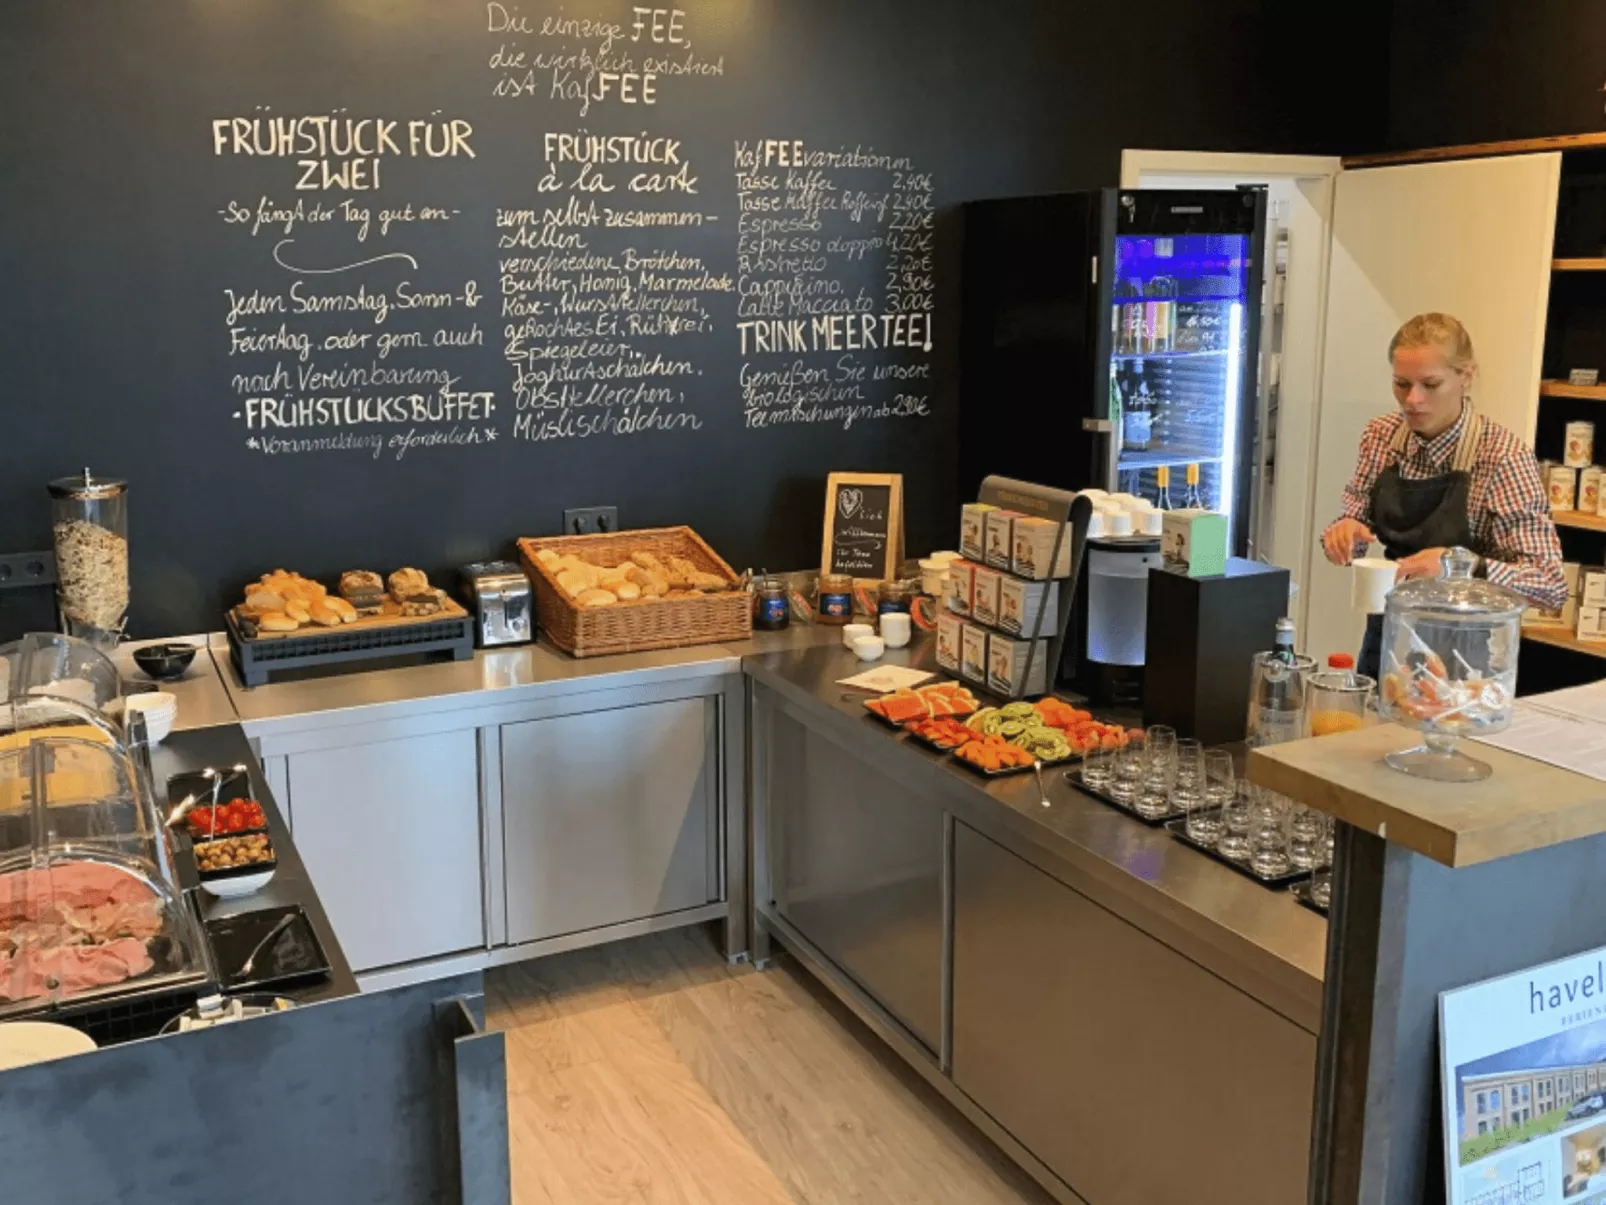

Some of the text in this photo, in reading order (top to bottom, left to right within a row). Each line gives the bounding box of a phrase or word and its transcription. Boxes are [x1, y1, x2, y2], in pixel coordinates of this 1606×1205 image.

[540, 6, 626, 54] einzige
[631, 6, 691, 48] FEE,
[489, 43, 529, 69] die
[533, 46, 637, 76] wirklich
[493, 70, 539, 97] ist
[212, 105, 477, 159] FRÜHSTÜCK FÜR
[544, 129, 681, 165] FRÜHSTÜCK
[295, 157, 381, 190] ZWEI
[537, 160, 699, 194] à la carte
[735, 172, 780, 190] Tasse
[784, 170, 837, 193] Kaffee
[496, 207, 540, 227] zum
[543, 194, 600, 227] selbst
[737, 191, 782, 211] Tasse
[251, 196, 304, 237] fängt
[307, 202, 335, 223] der
[340, 199, 370, 243] Tag
[378, 203, 414, 237] gut
[498, 224, 588, 248] stellen
[738, 212, 822, 236] Espresso
[737, 235, 821, 259] Espresso
[224, 289, 286, 325] Jeden
[324, 328, 372, 351] oder
[433, 322, 484, 347] auch
[736, 313, 933, 355] TRINK MEER TEE!
[232, 361, 461, 397] nach Vereinbarung
[835, 353, 865, 382] Sie
[872, 364, 930, 381] unsere
